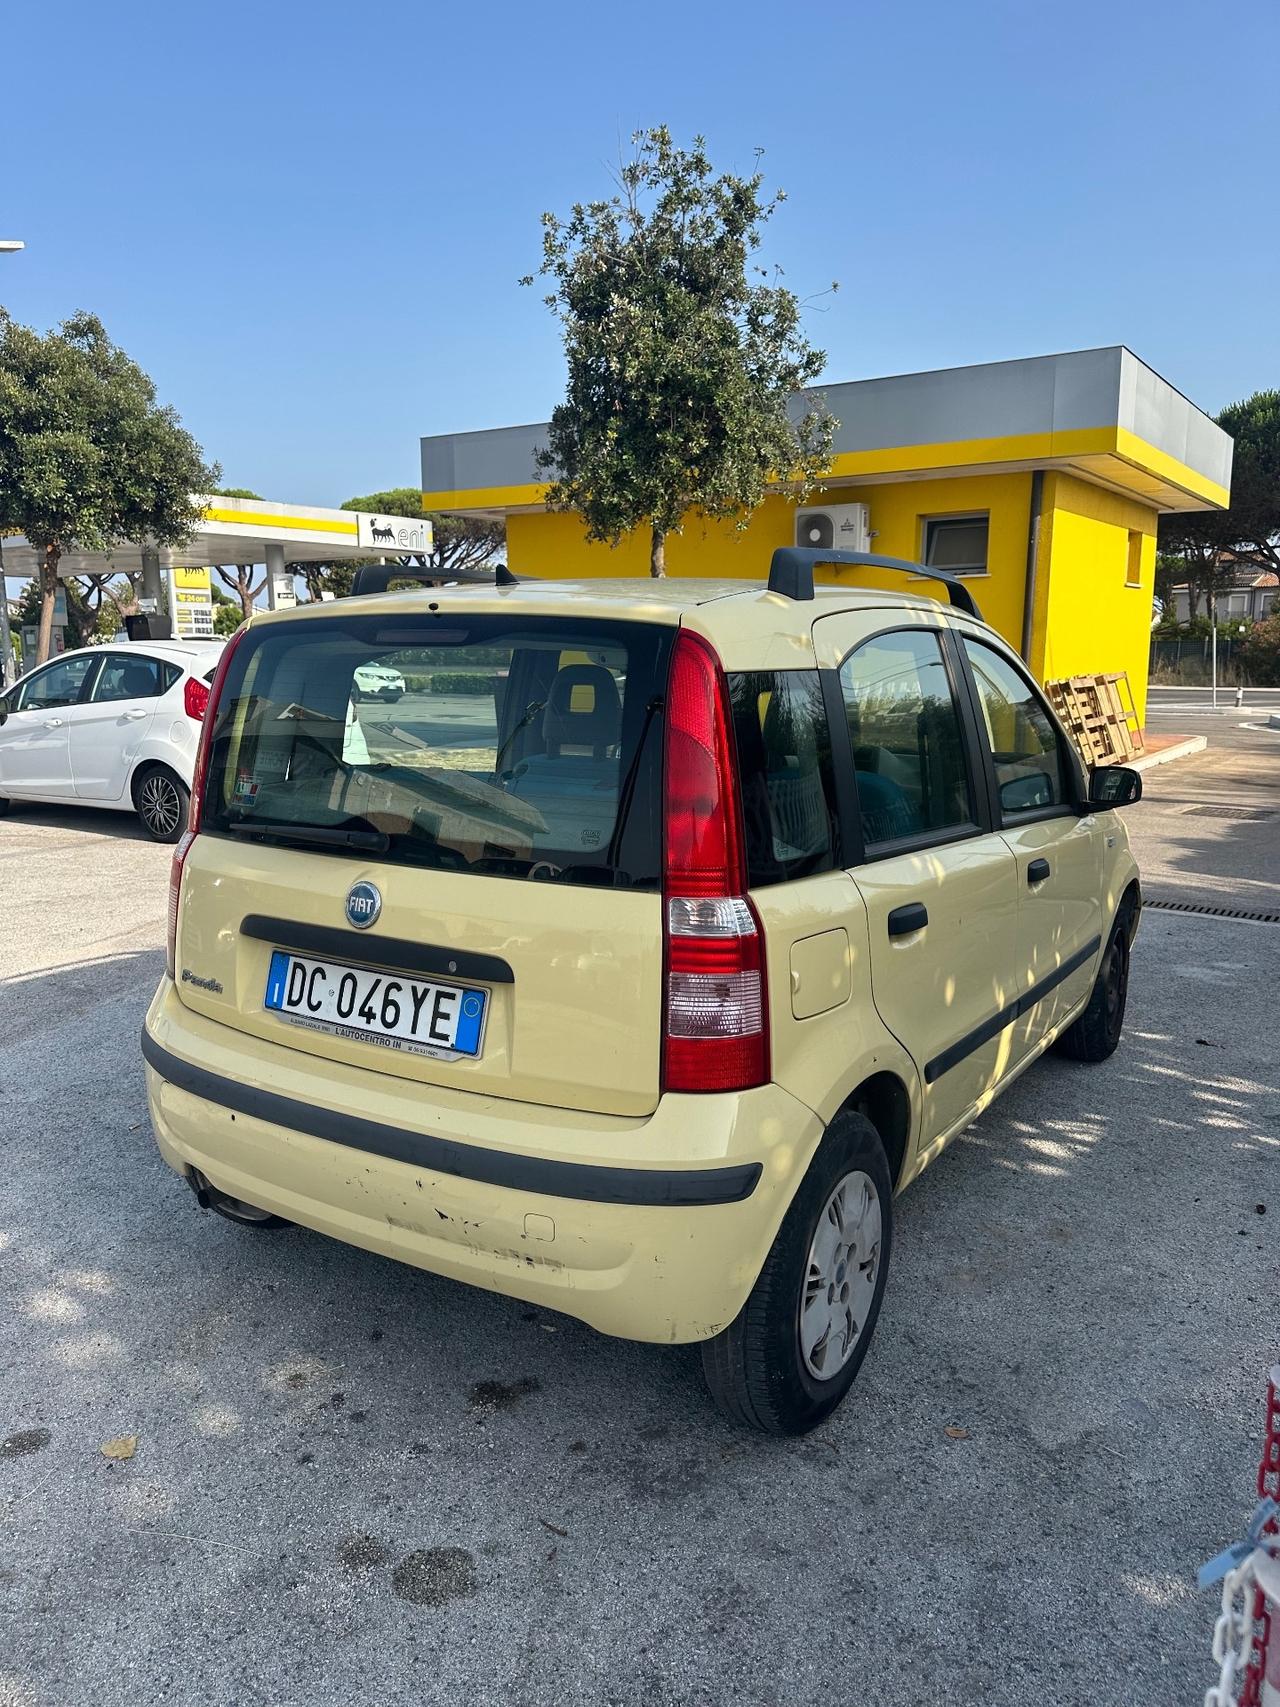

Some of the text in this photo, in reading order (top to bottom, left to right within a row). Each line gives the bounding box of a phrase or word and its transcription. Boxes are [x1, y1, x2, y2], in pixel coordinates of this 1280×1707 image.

[398, 525, 425, 549] eni
[349, 896, 374, 914] FIAT
[287, 961, 457, 1042] DC 046YE
[335, 1027, 391, 1047] L'AUTOCENTRO
